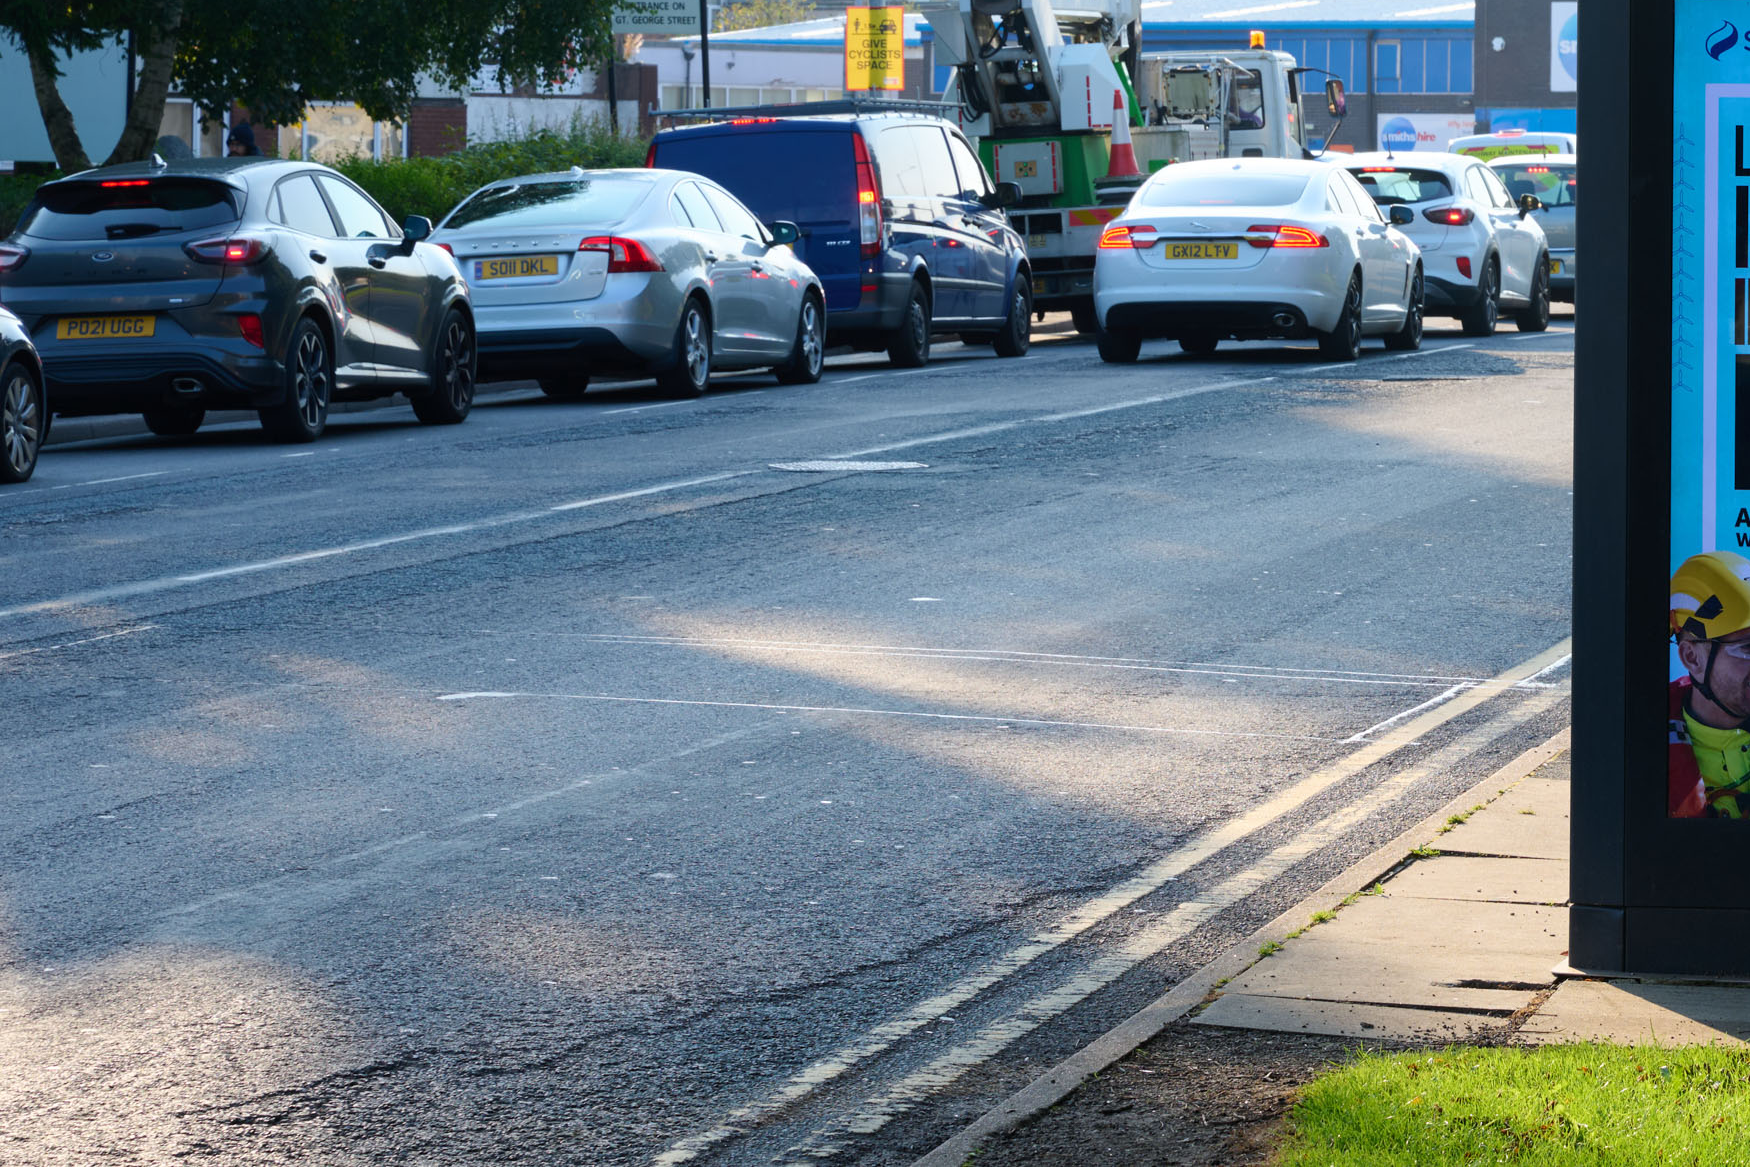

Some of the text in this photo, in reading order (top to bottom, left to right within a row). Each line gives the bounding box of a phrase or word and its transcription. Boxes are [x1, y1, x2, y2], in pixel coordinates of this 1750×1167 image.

[672, 2, 686, 11] ON
[632, 16, 665, 25] GEORGE
[667, 16, 697, 25] STREET
[862, 39, 888, 49] GIVE
[848, 50, 901, 60] CYCLISTS
[857, 61, 893, 71] SPACE
[1382, 131, 1437, 142] smiths hire
[1172, 245, 1231, 259] GX12 LTV
[490, 259, 549, 276] SO11 DKL
[110, 318, 144, 334] UGG
